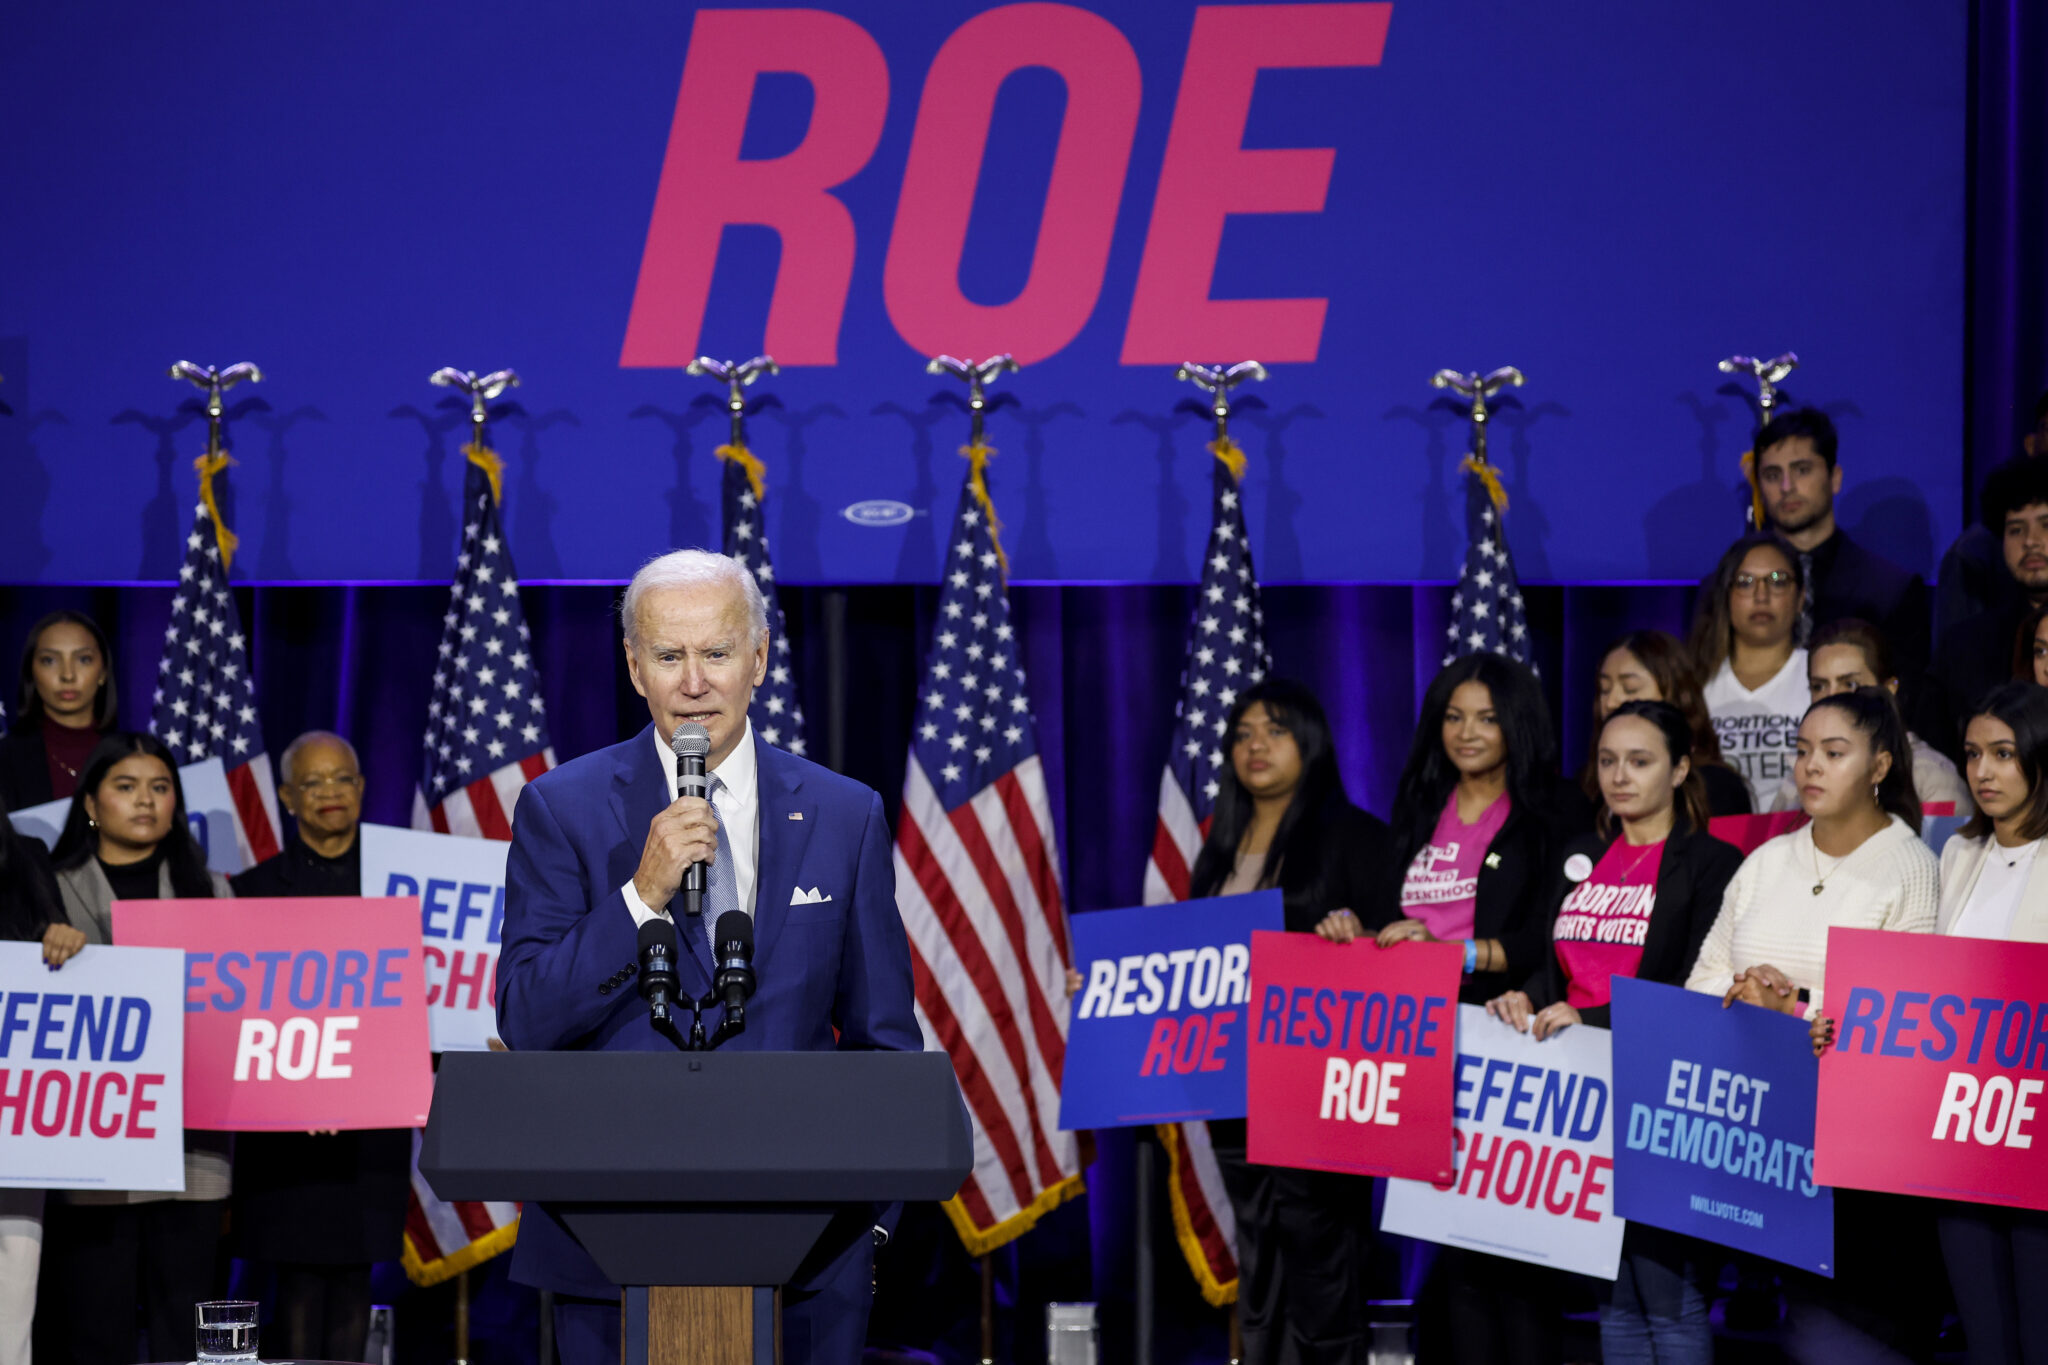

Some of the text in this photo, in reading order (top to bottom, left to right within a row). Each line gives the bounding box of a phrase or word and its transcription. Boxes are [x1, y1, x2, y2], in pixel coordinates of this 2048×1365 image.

[618, 1, 1393, 367] ROE
[1718, 730, 1798, 750] STICE
[1596, 917, 1649, 946] VOTER
[423, 945, 502, 1010] CH
[1078, 943, 1252, 1019] RESTOR
[0, 991, 151, 1062] FEND
[233, 1016, 359, 1081] ROE
[1139, 1011, 1237, 1077] ROE
[1258, 984, 1447, 1057] RESTORE
[1320, 1057, 1406, 1126] ROE
[1665, 1059, 1770, 1127] ELECT
[1931, 1071, 2045, 1149] ROE
[1626, 1102, 1819, 1198] DEMOCRATS
